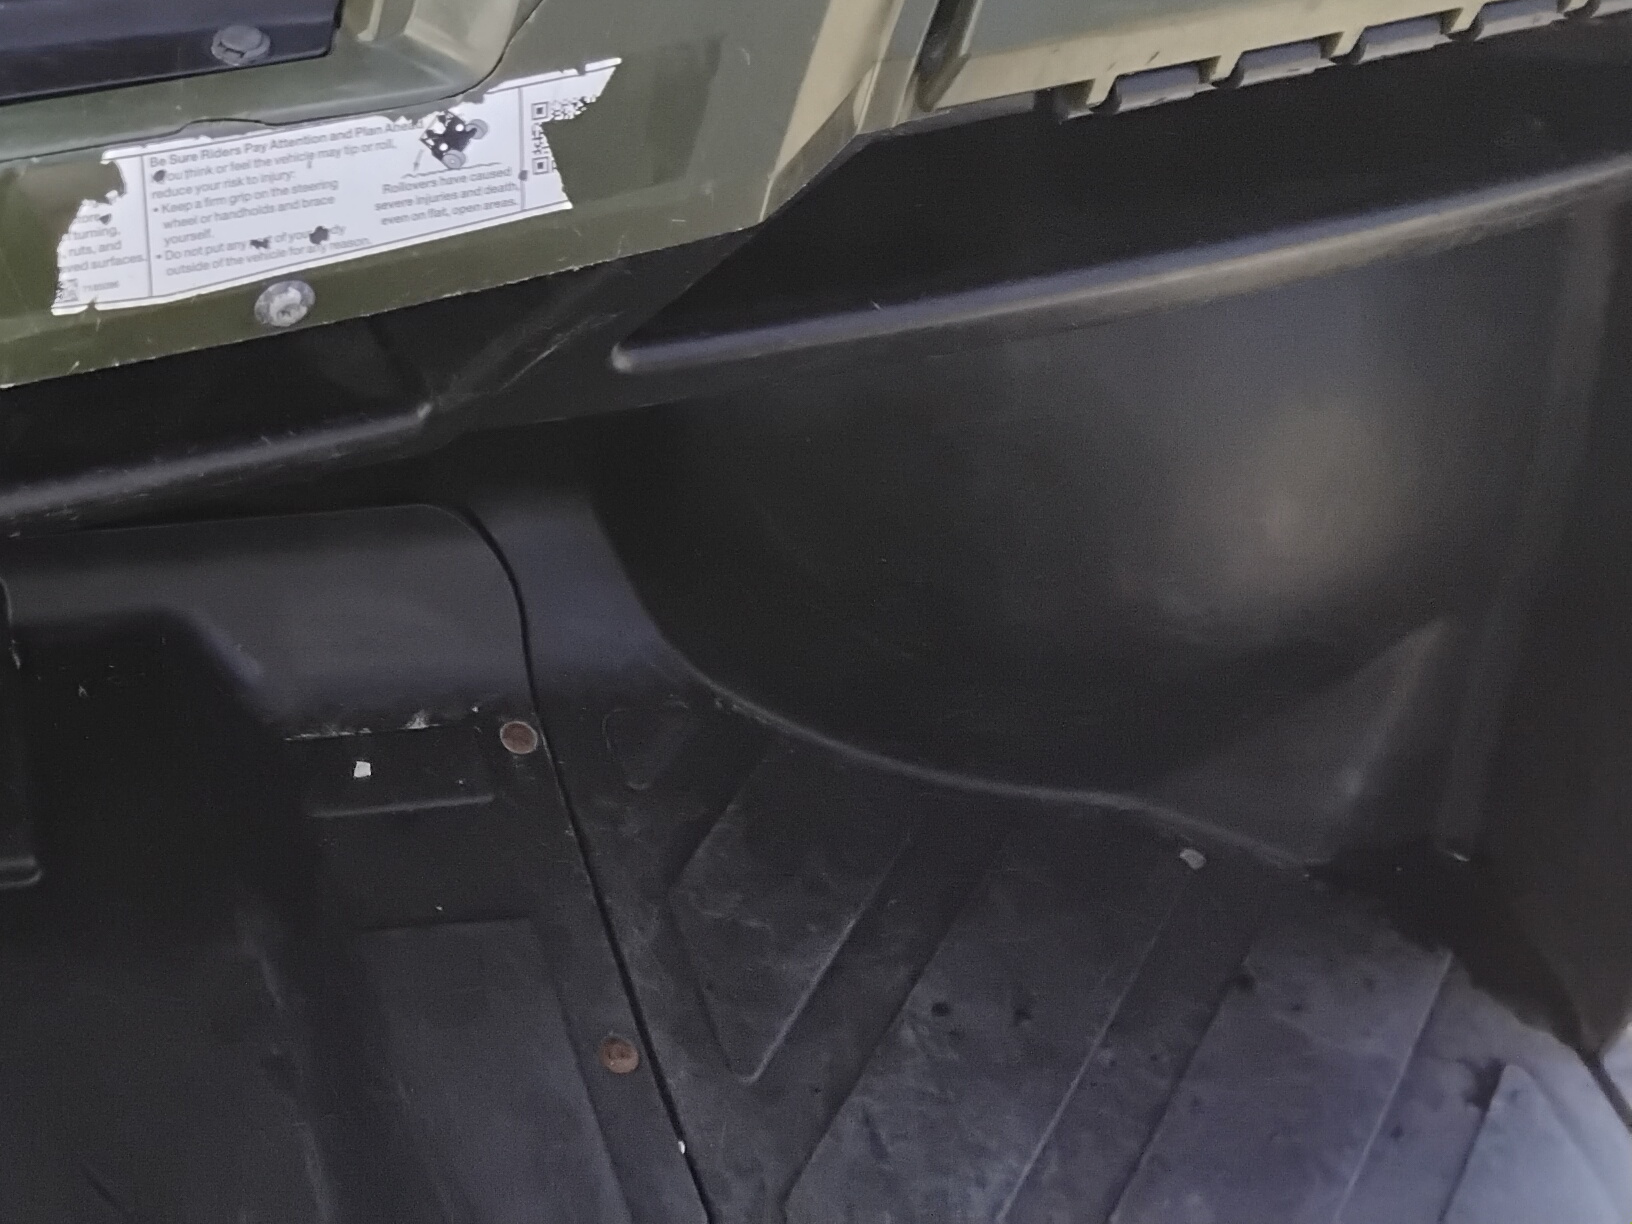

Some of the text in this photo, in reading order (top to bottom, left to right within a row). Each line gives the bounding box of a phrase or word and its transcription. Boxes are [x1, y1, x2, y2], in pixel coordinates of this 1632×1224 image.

[150, 121, 424, 167] Be Sure Riders Pay Attention and Plan Ahead
[185, 167, 213, 180] think
[215, 164, 228, 174] or
[230, 160, 251, 172] feel
[254, 157, 273, 168] the
[274, 152, 314, 166] vehicle
[318, 148, 341, 159] may
[344, 145, 359, 156] tip
[361, 143, 374, 153] or
[152, 185, 193, 199] reduce
[195, 182, 221, 196] your
[223, 178, 244, 190] risk
[246, 175, 259, 186] to
[381, 167, 513, 194] Rollovers have caused
[162, 180, 339, 214] Keep a firm grip on the steering
[374, 198, 414, 211] severe
[415, 192, 458, 206] injuries
[460, 187, 482, 199] and
[163, 195, 336, 229] wheel or handholds and brace
[381, 215, 409, 226] even
[411, 212, 427, 222] on
[451, 203, 482, 216] open
[98, 241, 122, 253] and
[164, 249, 182, 261] Do
[184, 245, 203, 257] not
[205, 242, 224, 256] put
[226, 240, 247, 252] any
[274, 232, 287, 243] of
[166, 261, 211, 276] outside
[212, 257, 224, 269] of
[225, 254, 244, 266] the
[246, 249, 287, 264] vehicle
[289, 244, 305, 256] for
[306, 243, 327, 254] any
